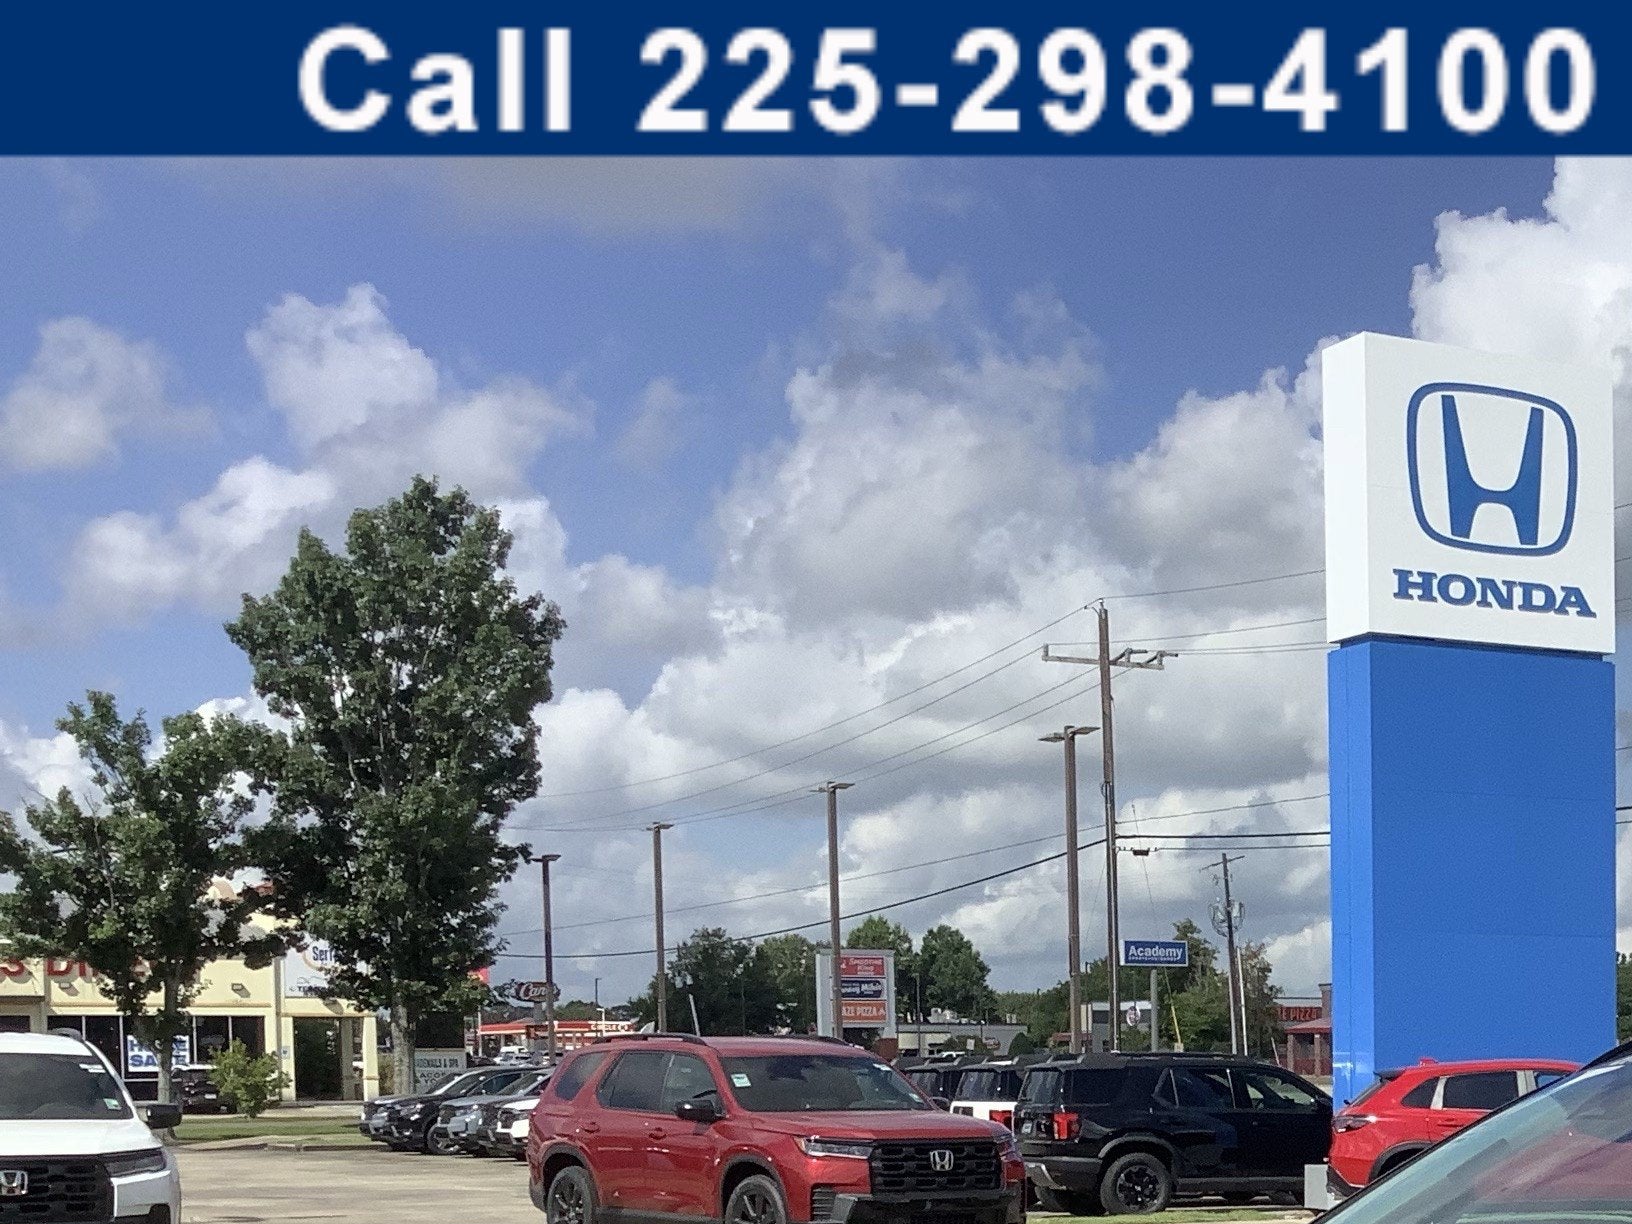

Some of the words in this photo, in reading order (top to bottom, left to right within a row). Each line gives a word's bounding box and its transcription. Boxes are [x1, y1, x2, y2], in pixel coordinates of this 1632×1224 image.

[1392, 568, 1597, 618] HONDA
[1128, 945, 1183, 960] Academy
[130, 1054, 187, 1067] SAE
